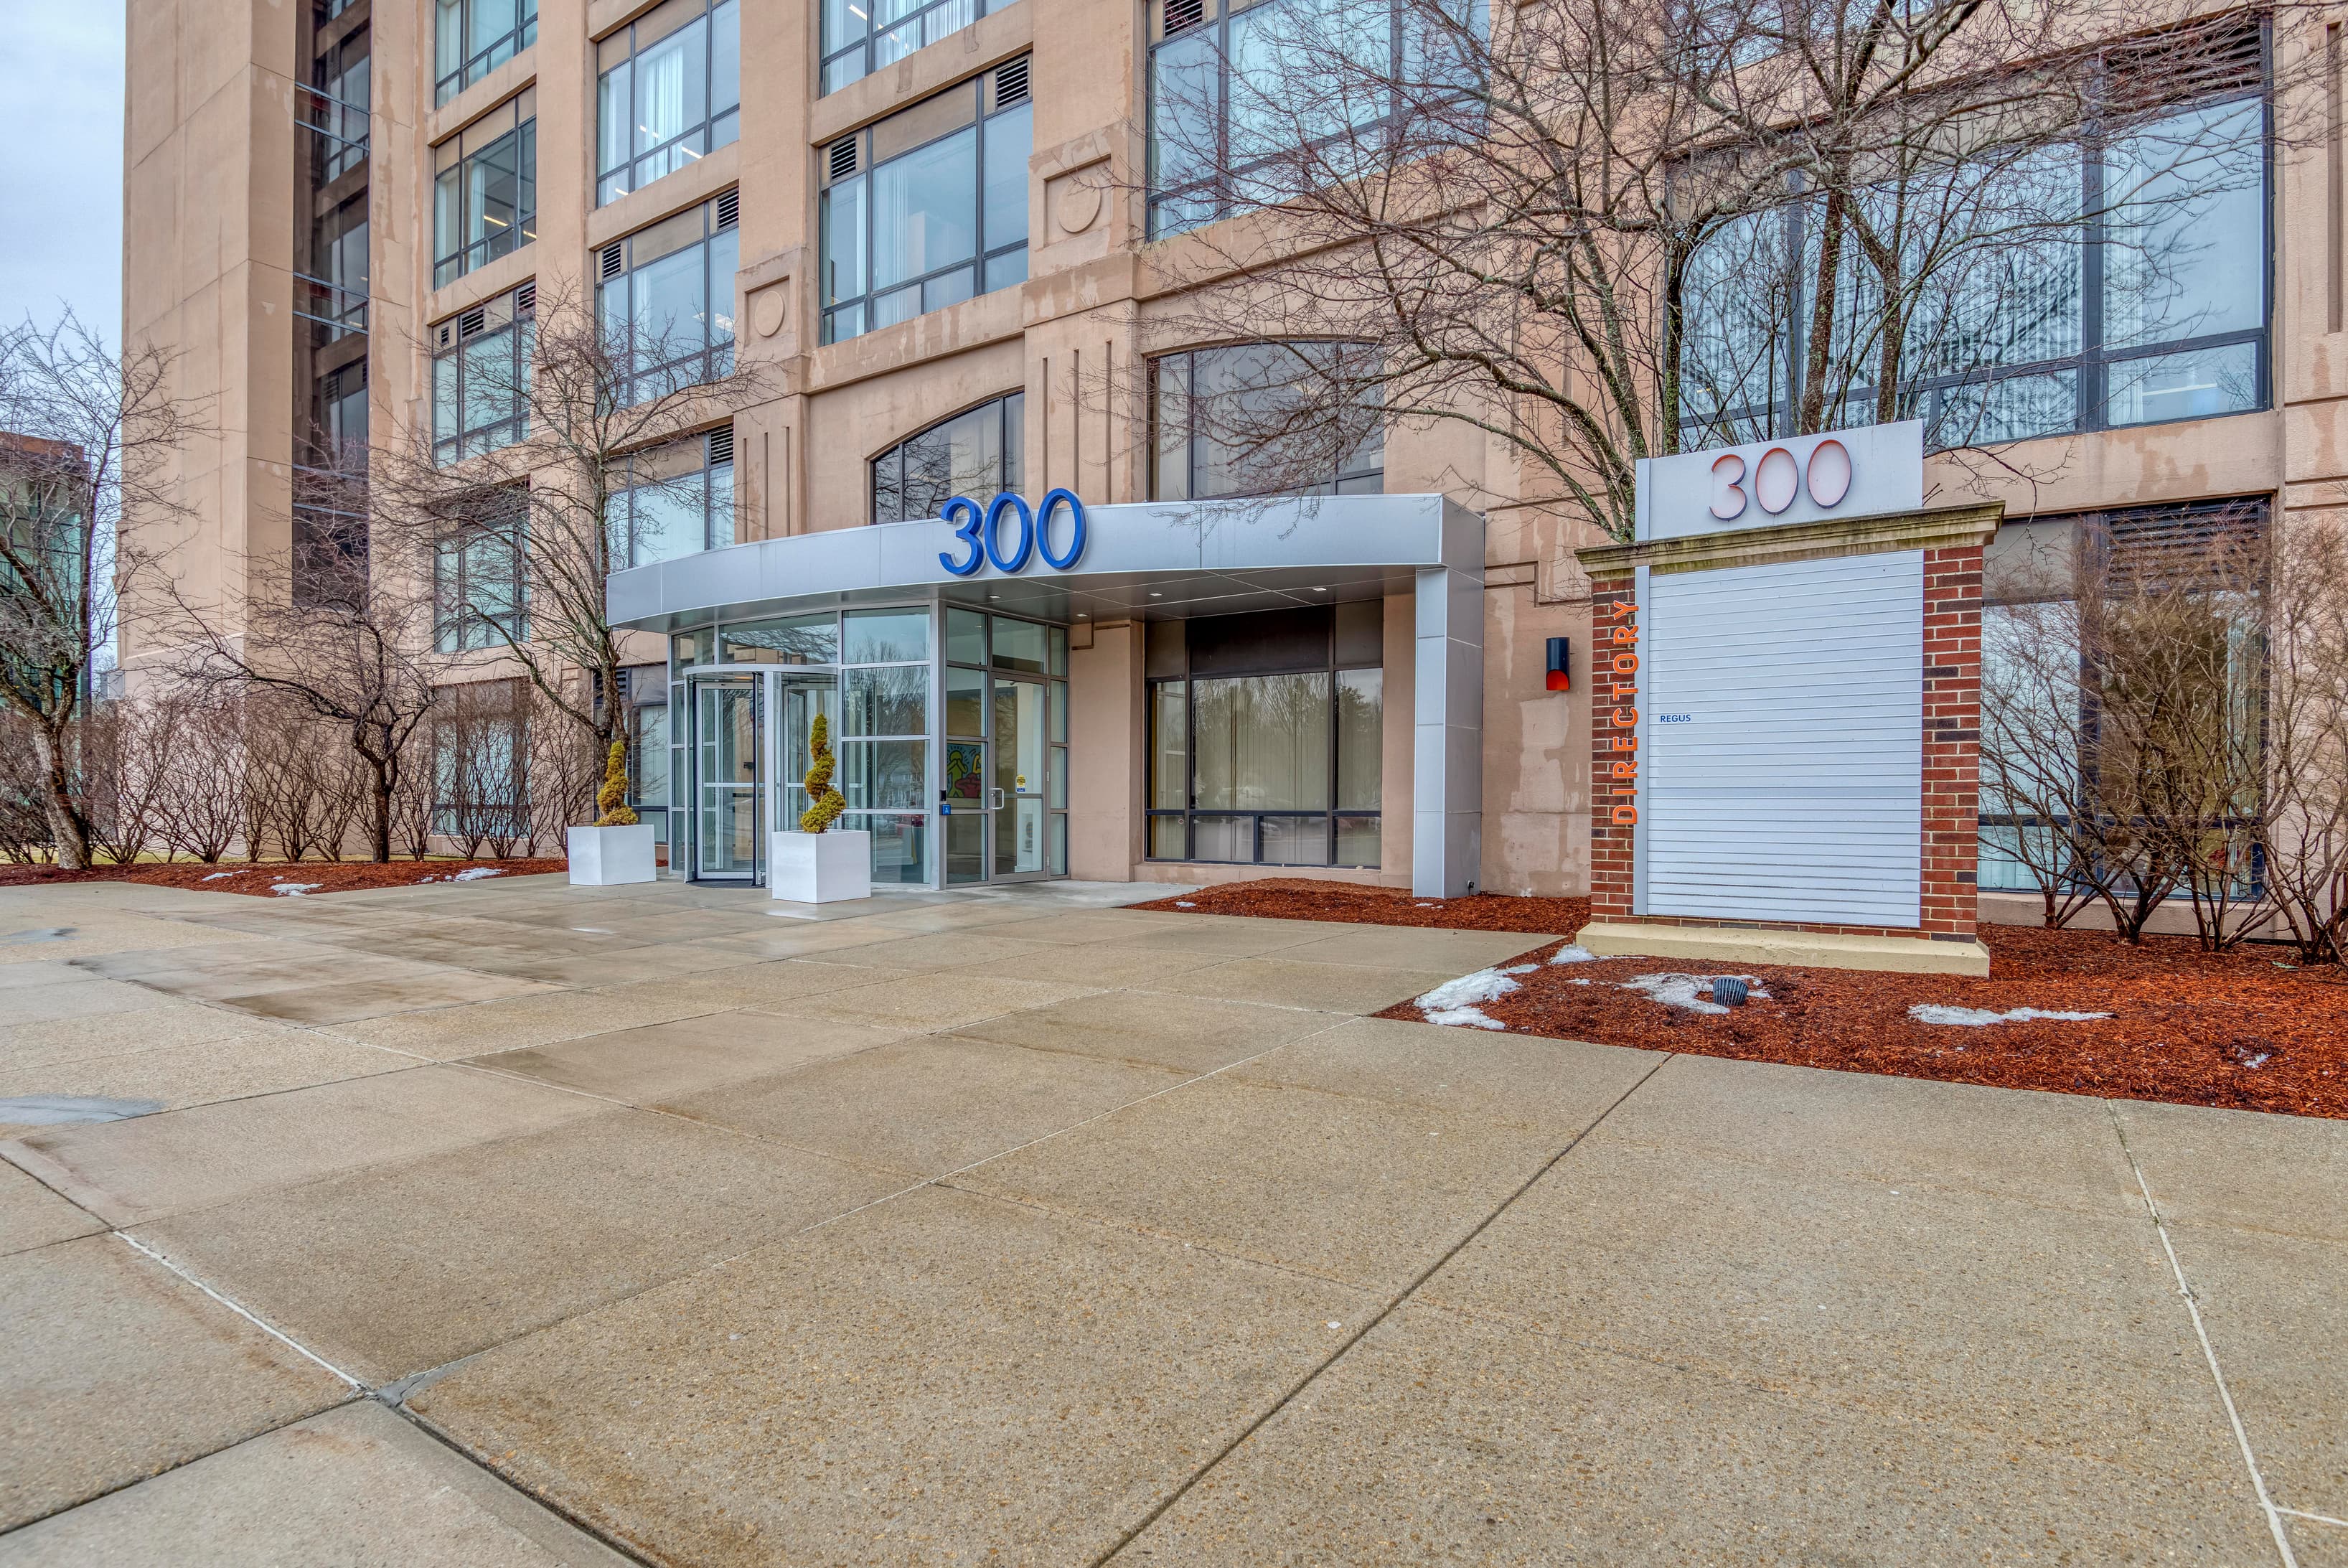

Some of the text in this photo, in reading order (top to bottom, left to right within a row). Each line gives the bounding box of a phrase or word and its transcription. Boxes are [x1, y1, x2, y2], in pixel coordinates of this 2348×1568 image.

[1709, 439, 1851, 521] 300
[939, 488, 1087, 577] 300
[1612, 600, 1639, 825] DIRECTORY
[1660, 714, 1691, 723] REGUS
